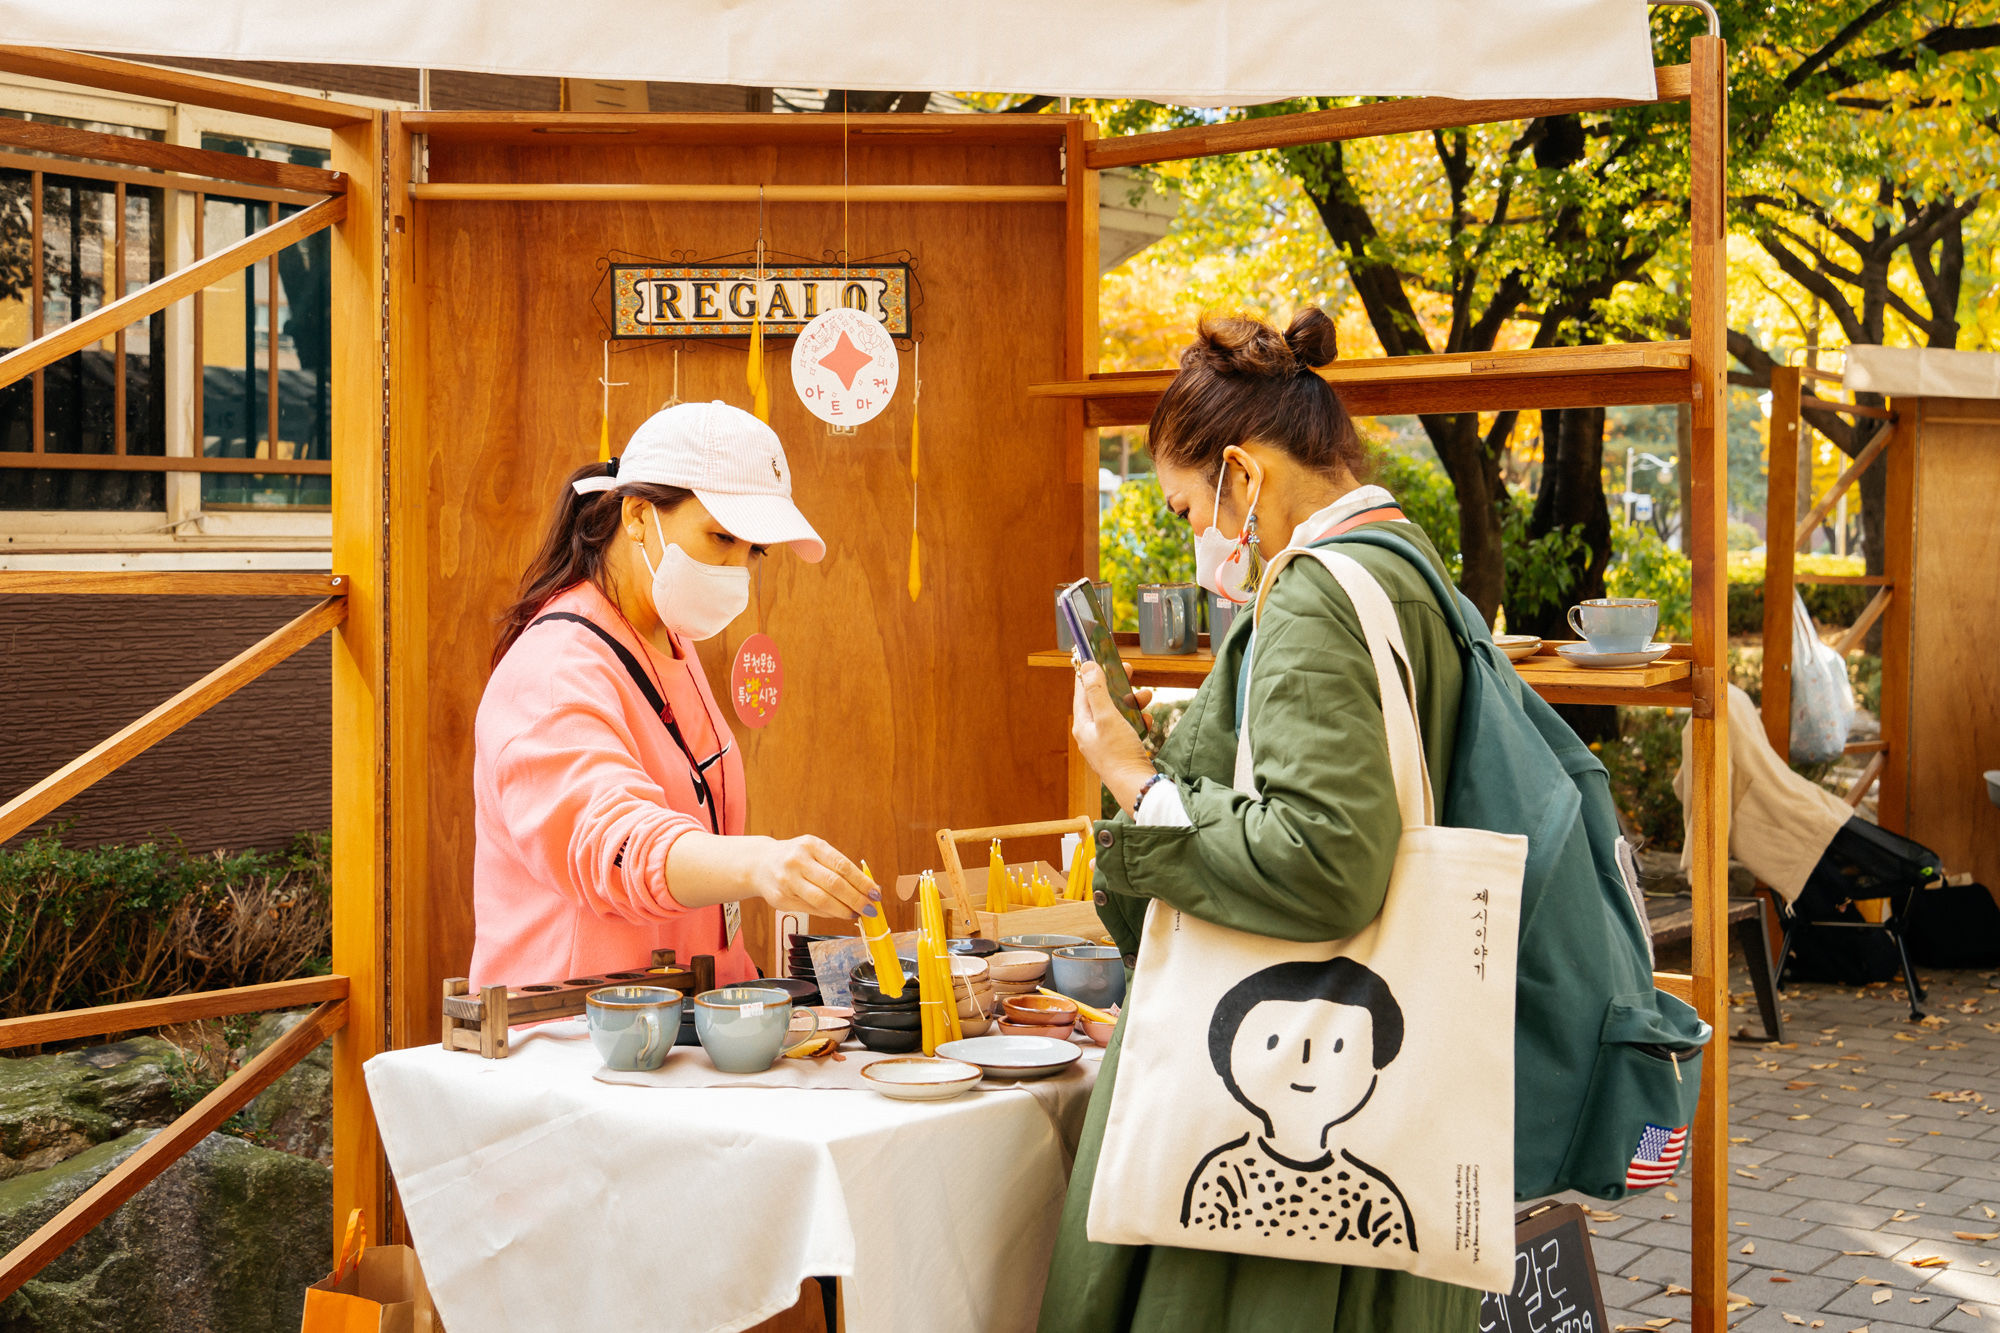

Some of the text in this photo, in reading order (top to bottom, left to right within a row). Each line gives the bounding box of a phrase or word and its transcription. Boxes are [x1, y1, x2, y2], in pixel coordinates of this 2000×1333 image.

[654, 281, 869, 321] REGALO
[805, 377, 889, 416] 아트마켓
[743, 652, 776, 674] 부천문화
[1471, 888, 1489, 981] 제시이야기
